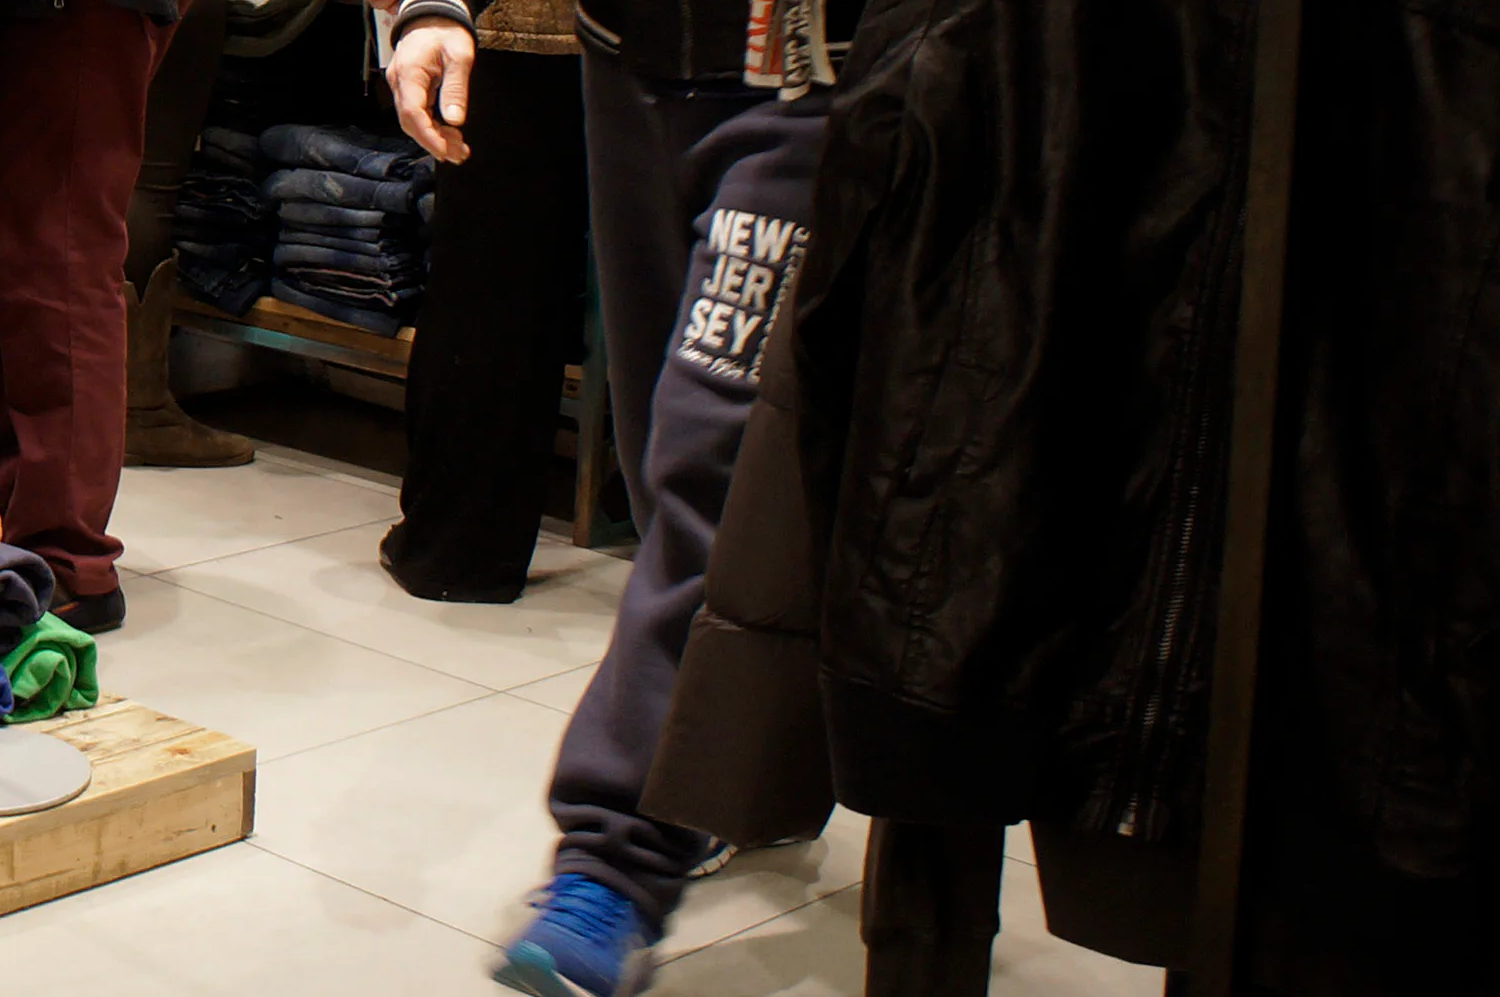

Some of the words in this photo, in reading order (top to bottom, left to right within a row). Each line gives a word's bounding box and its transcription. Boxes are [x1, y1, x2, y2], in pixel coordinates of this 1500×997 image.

[707, 208, 797, 264] NEW
[701, 254, 775, 311] JER
[684, 296, 763, 357] SEY
